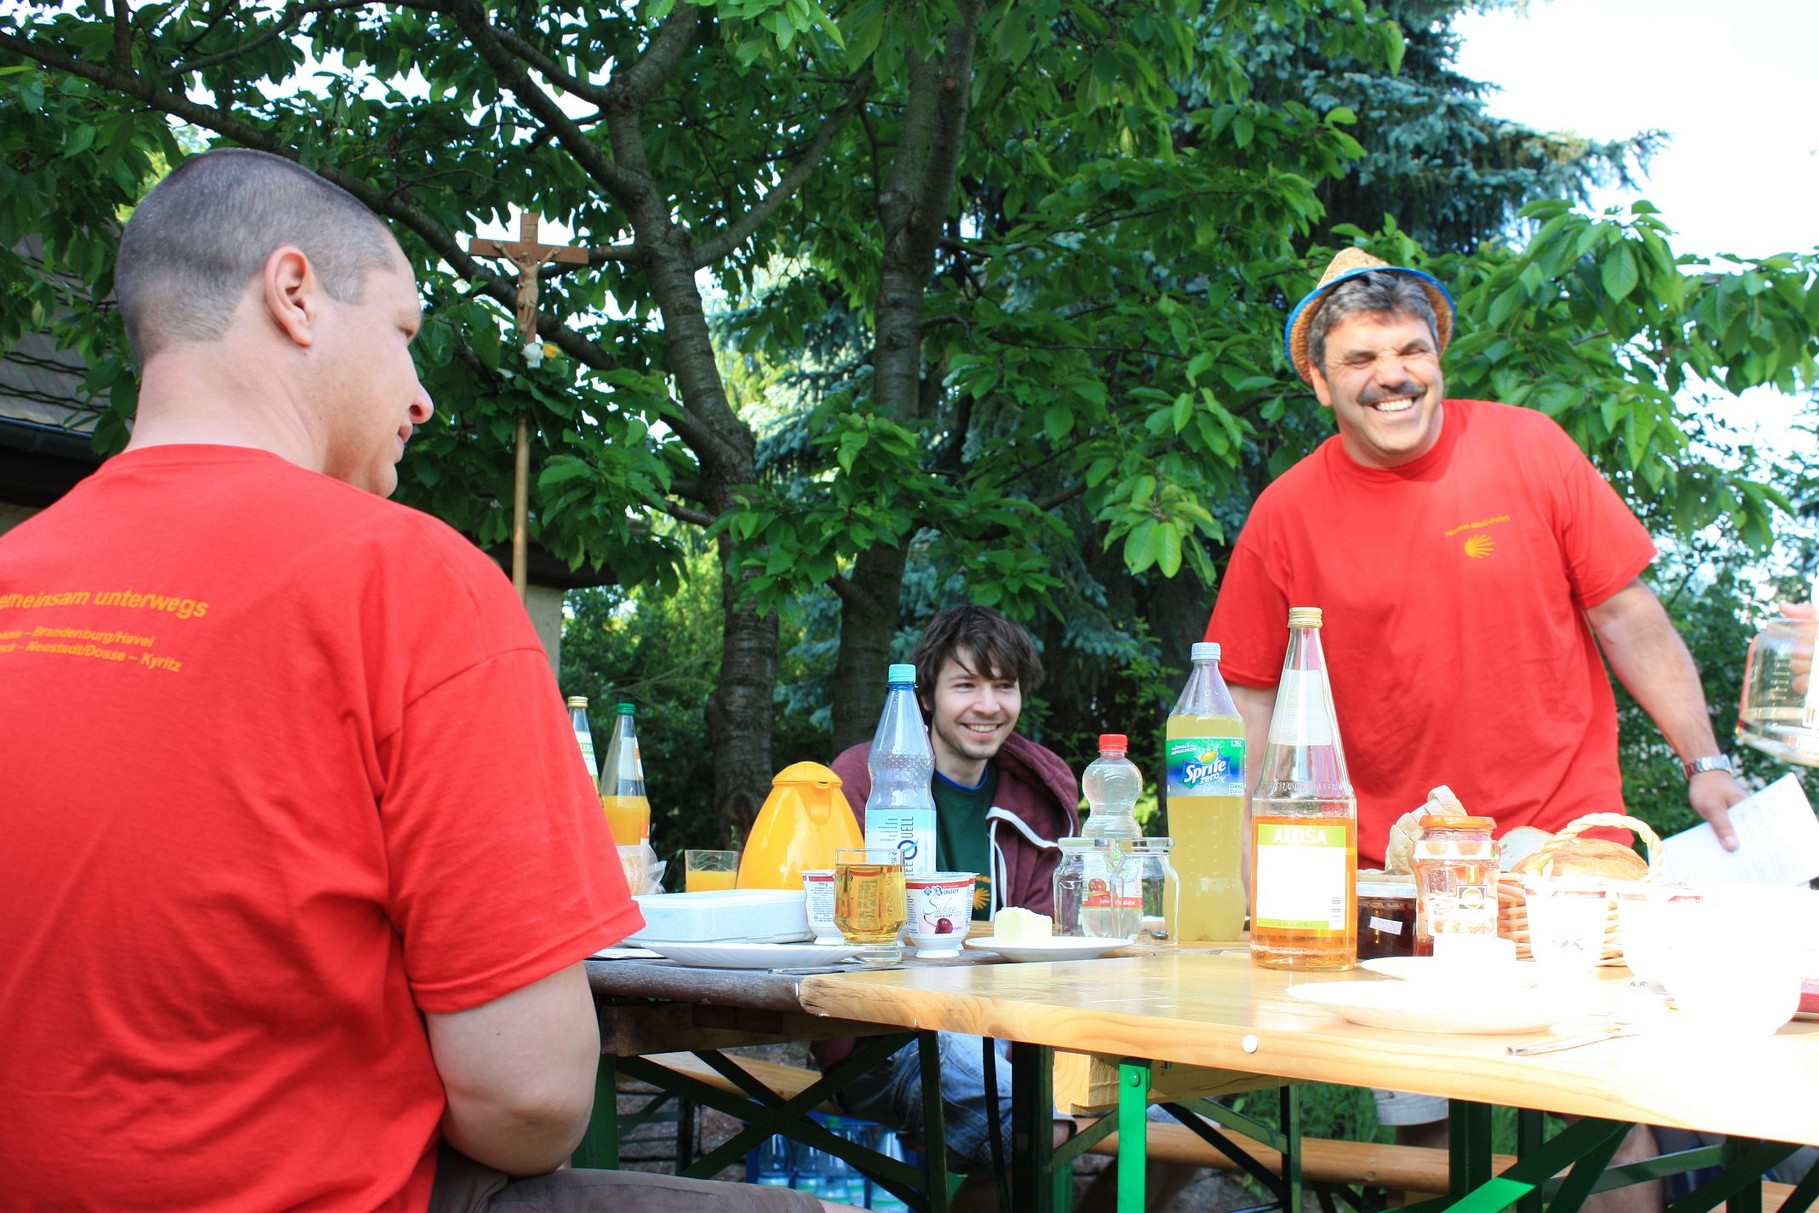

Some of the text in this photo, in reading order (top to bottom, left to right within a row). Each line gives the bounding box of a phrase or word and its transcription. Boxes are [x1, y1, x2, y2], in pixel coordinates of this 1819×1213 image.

[94, 589, 209, 619] unterwegs
[32, 626, 156, 648] Brandenburg/Havel
[25, 641, 126, 662] Neustadt/Dosse
[140, 652, 183, 673] Kyritz
[1183, 760, 1226, 784] Sprite
[1200, 772, 1220, 785] zero
[930, 886, 960, 897] Bauer
